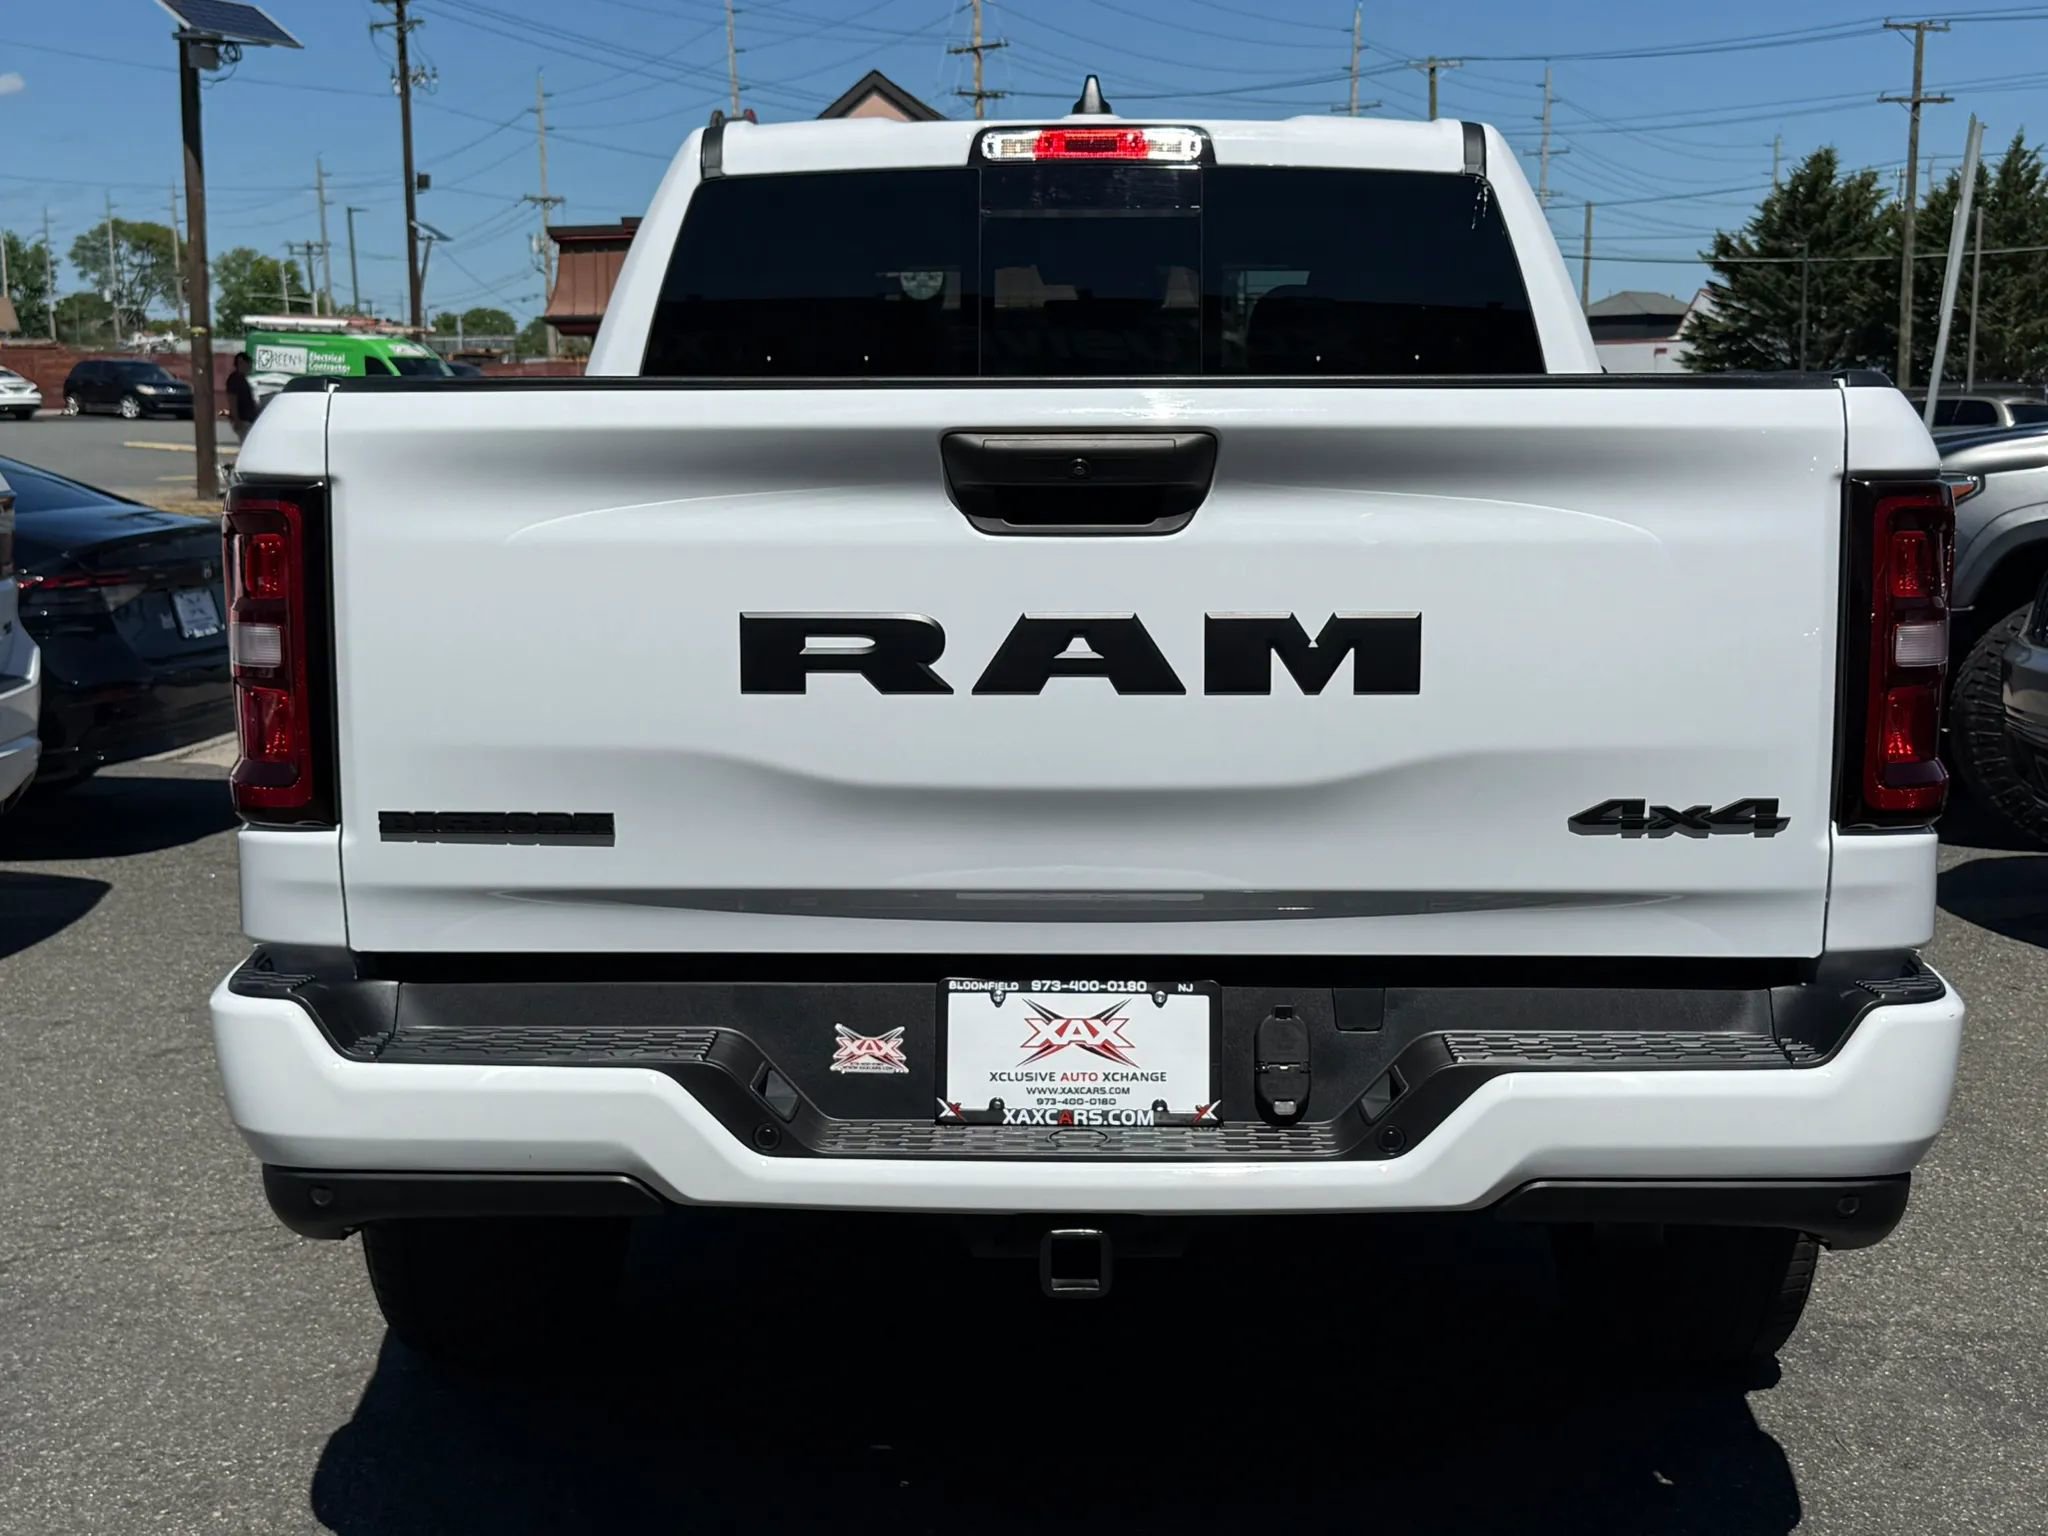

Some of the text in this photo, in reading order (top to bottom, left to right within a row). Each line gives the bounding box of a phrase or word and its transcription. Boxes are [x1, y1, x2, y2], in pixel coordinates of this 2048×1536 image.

[309, 351, 346, 363] Electrical
[740, 611, 1423, 695] RAM
[1567, 797, 1791, 839] 4x4
[948, 980, 1194, 992] BLOOMFIELD 973-400-0180 NJ
[1020, 1018, 1136, 1048] XAX
[833, 1038, 906, 1058] XAX
[989, 1072, 1167, 1082] XCLUSIVE AUTO XCHANGE
[1026, 1087, 1131, 1095] WWW.XAXCARS.COM
[1002, 1109, 1155, 1126] XAXCARS.COM
